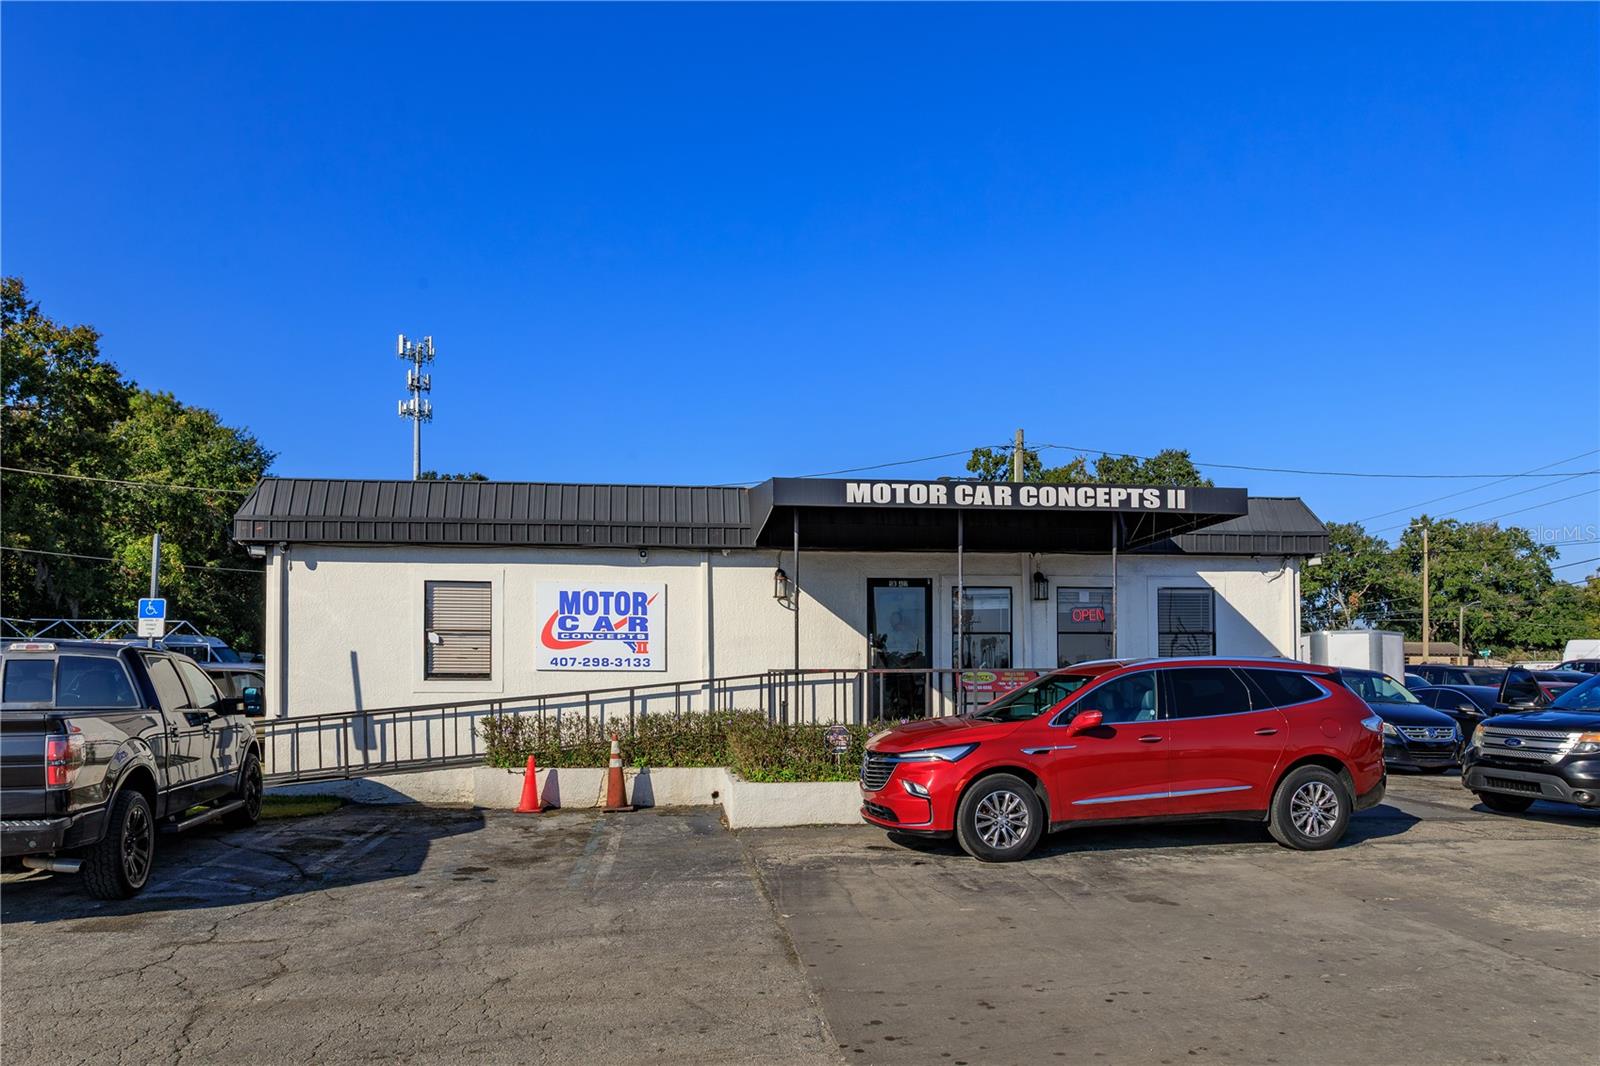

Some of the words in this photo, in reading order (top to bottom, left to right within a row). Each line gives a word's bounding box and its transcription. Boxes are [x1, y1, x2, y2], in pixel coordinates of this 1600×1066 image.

[846, 483, 947, 505] MOTOR
[954, 485, 1012, 506] CAR
[1019, 486, 1160, 509] CONCEPTS
[1167, 489, 1186, 509] II
[559, 590, 648, 616] MOTOR
[1072, 607, 1105, 622] OPEN
[550, 657, 651, 667] 407-298-3133
